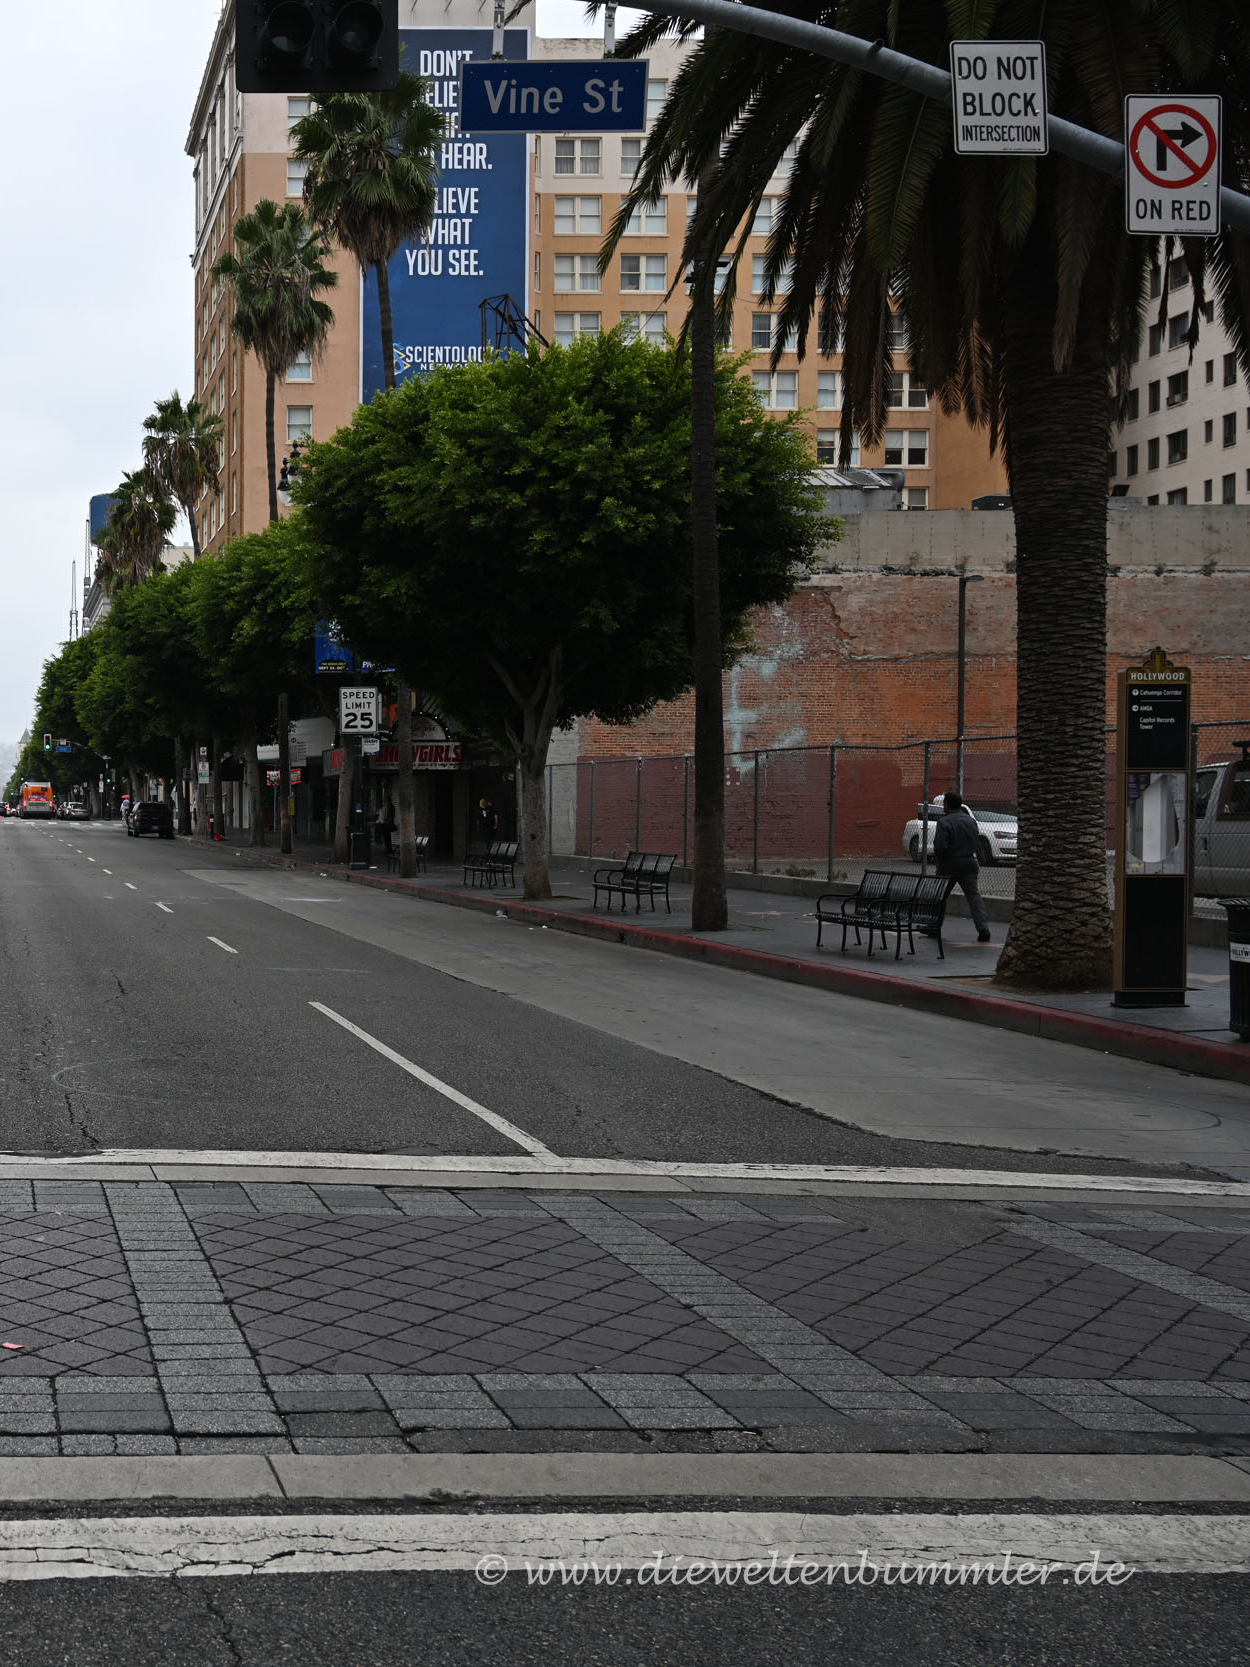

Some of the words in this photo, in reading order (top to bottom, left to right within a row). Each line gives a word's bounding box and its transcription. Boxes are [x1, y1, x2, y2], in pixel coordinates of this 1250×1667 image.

[957, 56, 987, 80] DO
[997, 56, 1038, 81] NOT
[484, 78, 563, 114] Vine
[582, 78, 624, 113] St
[962, 92, 1038, 117] BLOCK
[962, 124, 1041, 142] INTERSECTION
[441, 142, 493, 170] HEAR.
[432, 187, 479, 214] LIEVE
[1135, 198, 1162, 220] ON
[1171, 199, 1211, 221] RED
[405, 249, 443, 276] YOU
[448, 249, 484, 276] SEE.
[405, 346, 493, 364] SCIENTOLO
[1130, 672, 1185, 681] HOLLYWOOD
[342, 691, 375, 699] SPEED
[1139, 689, 1163, 697] Cahuenga
[345, 702, 372, 710] LIMIT
[344, 712, 374, 729] 25
[376, 745, 463, 763] HGIRLS
